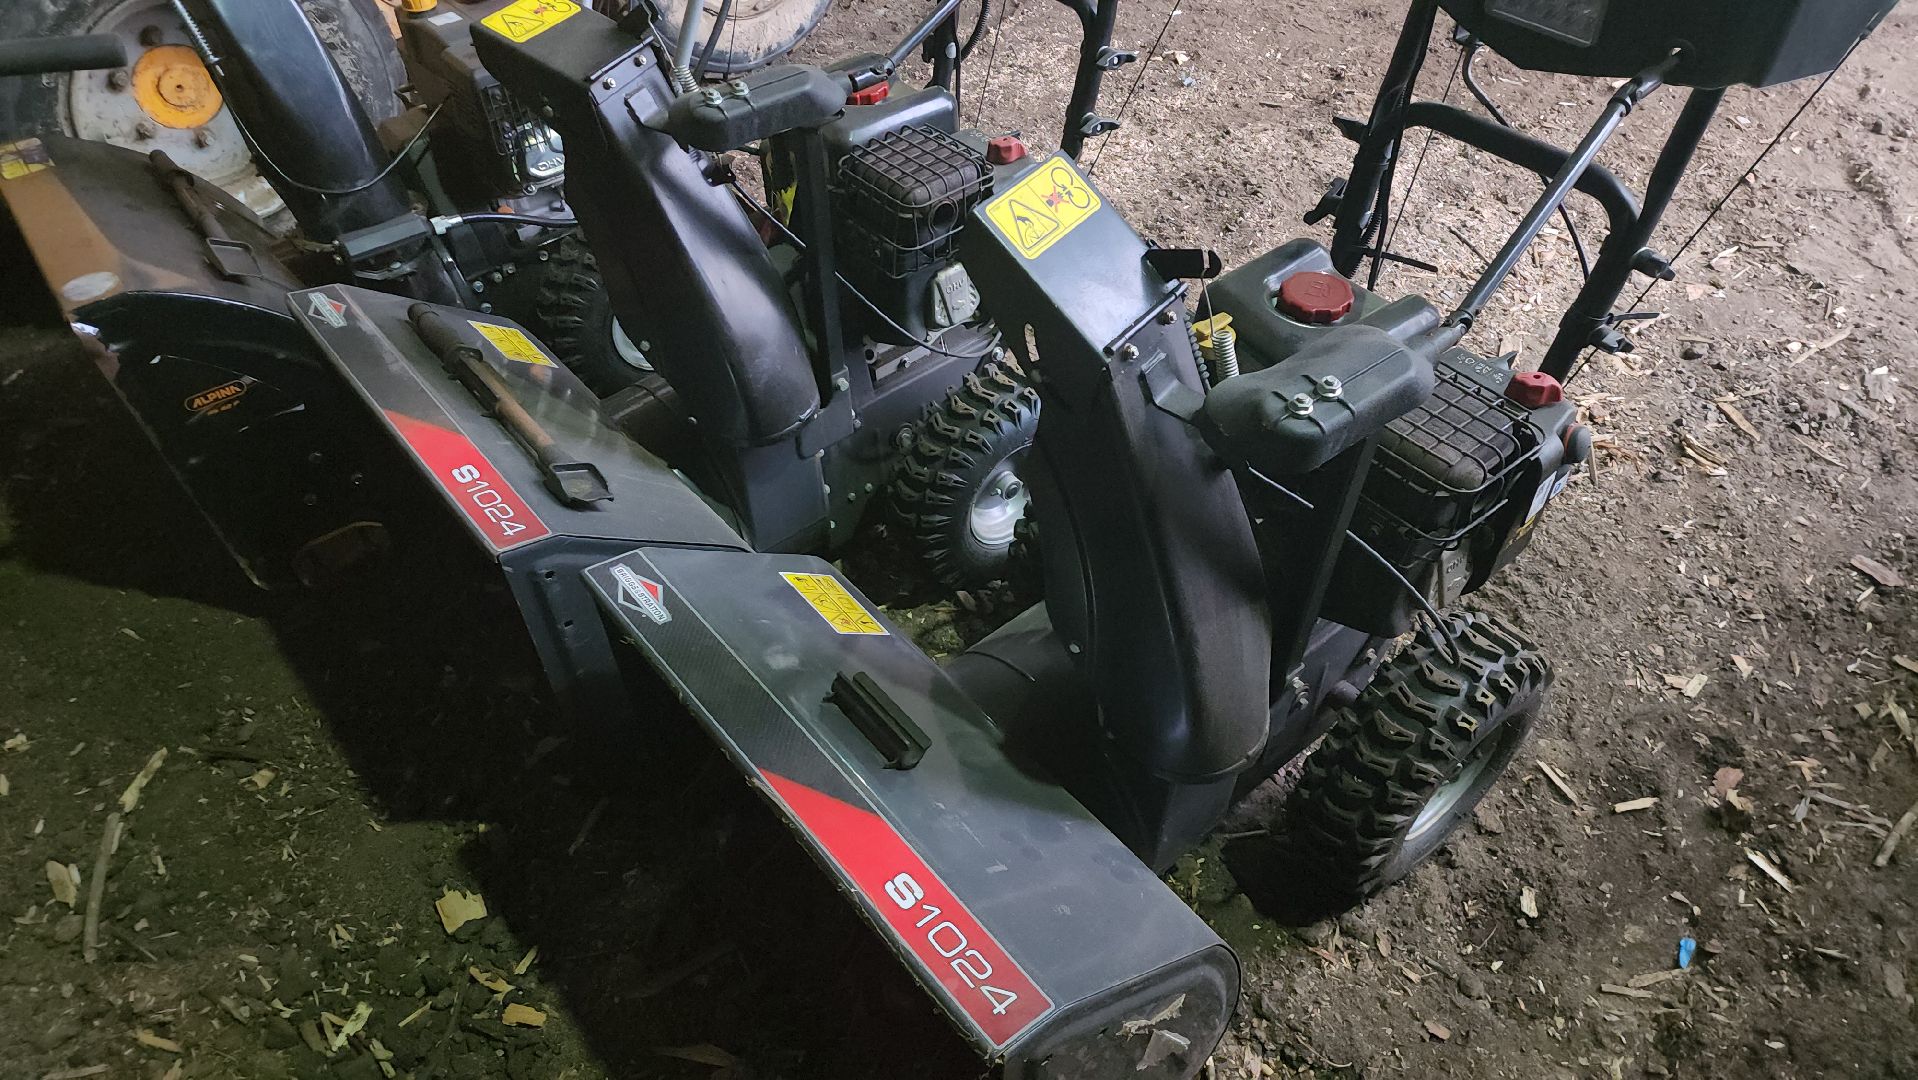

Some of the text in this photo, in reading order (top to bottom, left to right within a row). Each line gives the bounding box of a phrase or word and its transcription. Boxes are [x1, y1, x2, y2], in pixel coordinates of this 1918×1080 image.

[193, 385, 242, 409] ALPINA
[451, 464, 527, 536] S1024
[884, 872, 1018, 1015] S1024
